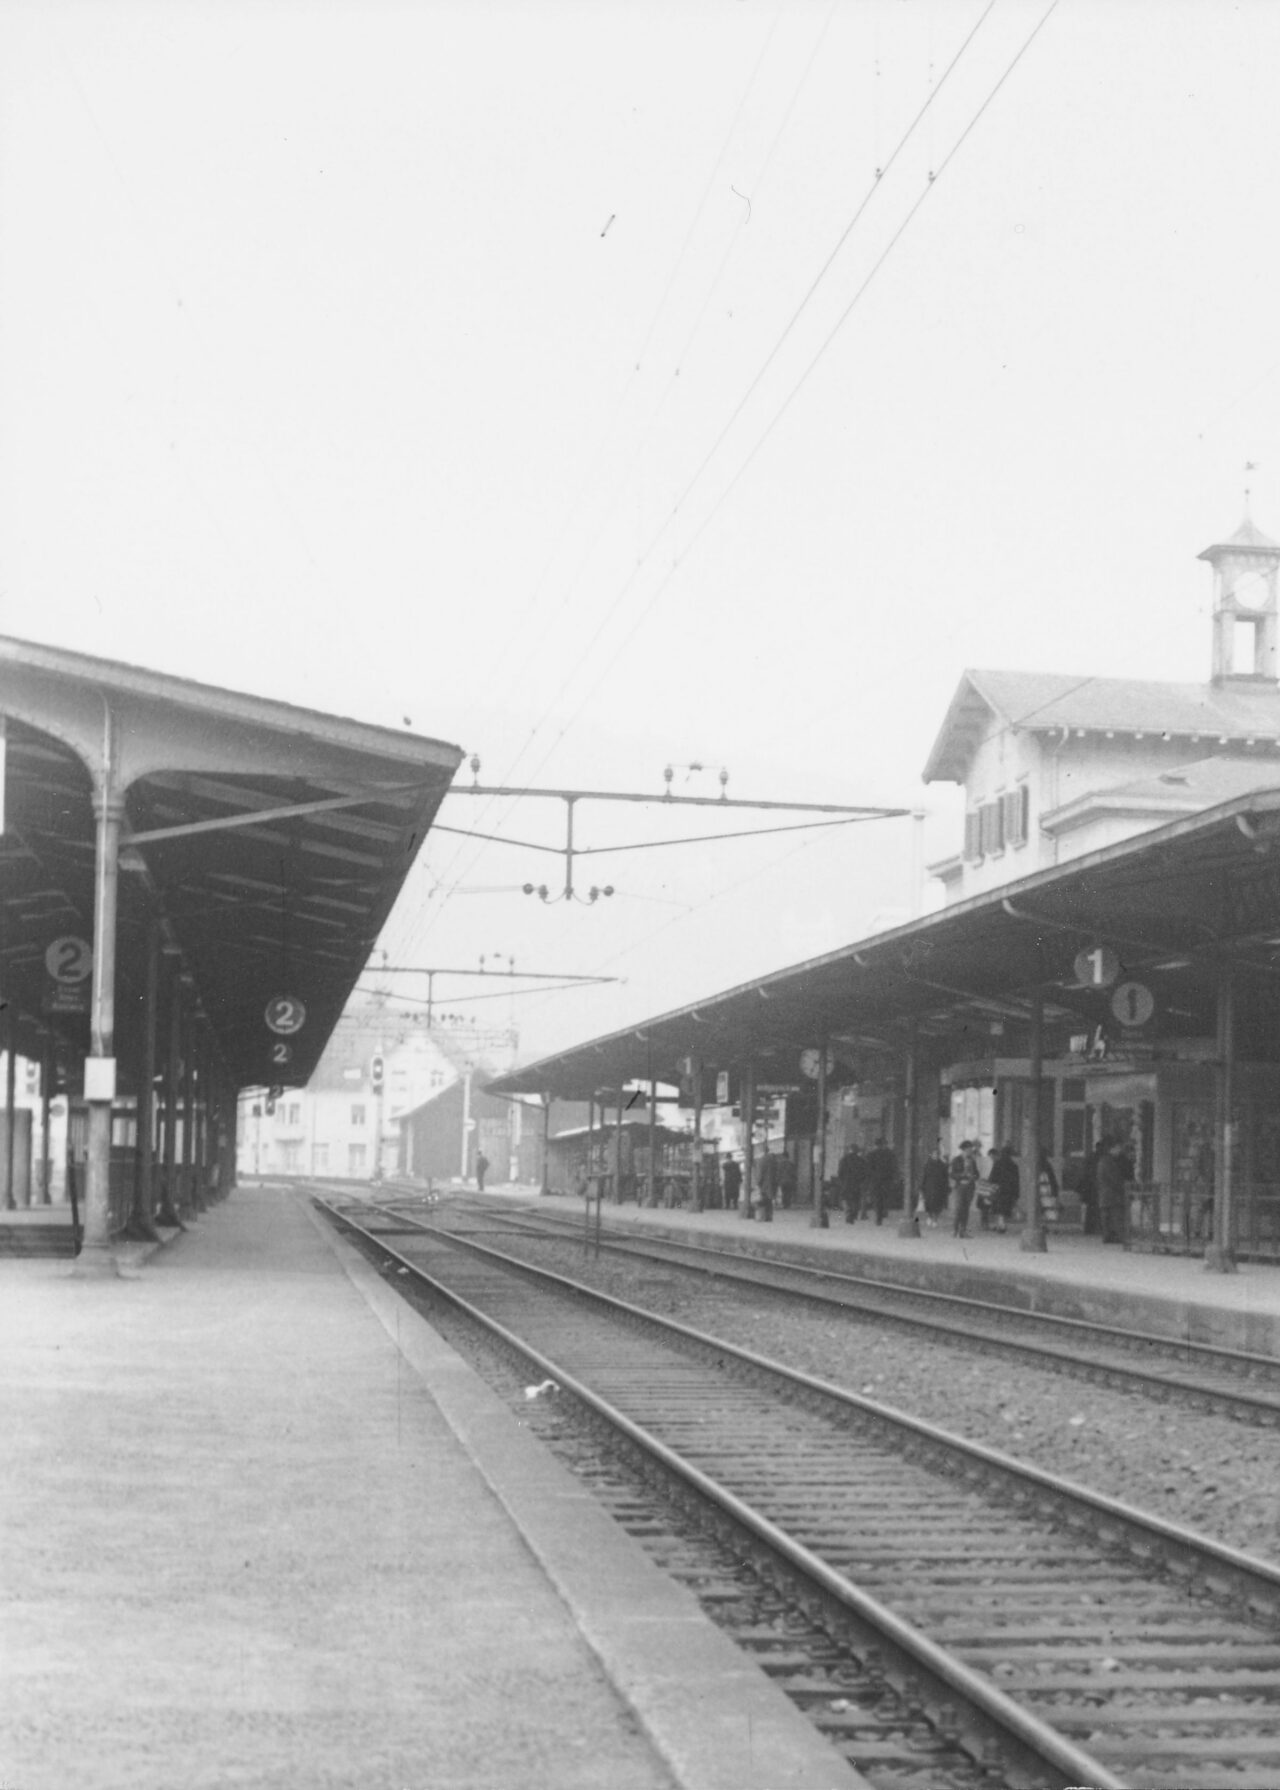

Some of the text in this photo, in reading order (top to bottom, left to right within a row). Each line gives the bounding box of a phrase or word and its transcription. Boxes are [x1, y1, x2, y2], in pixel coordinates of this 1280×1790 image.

[57, 943, 82, 977] 2
[1087, 949, 1103, 985] 1
[275, 1001, 294, 1026] 2
[273, 1044, 288, 1062] 2
